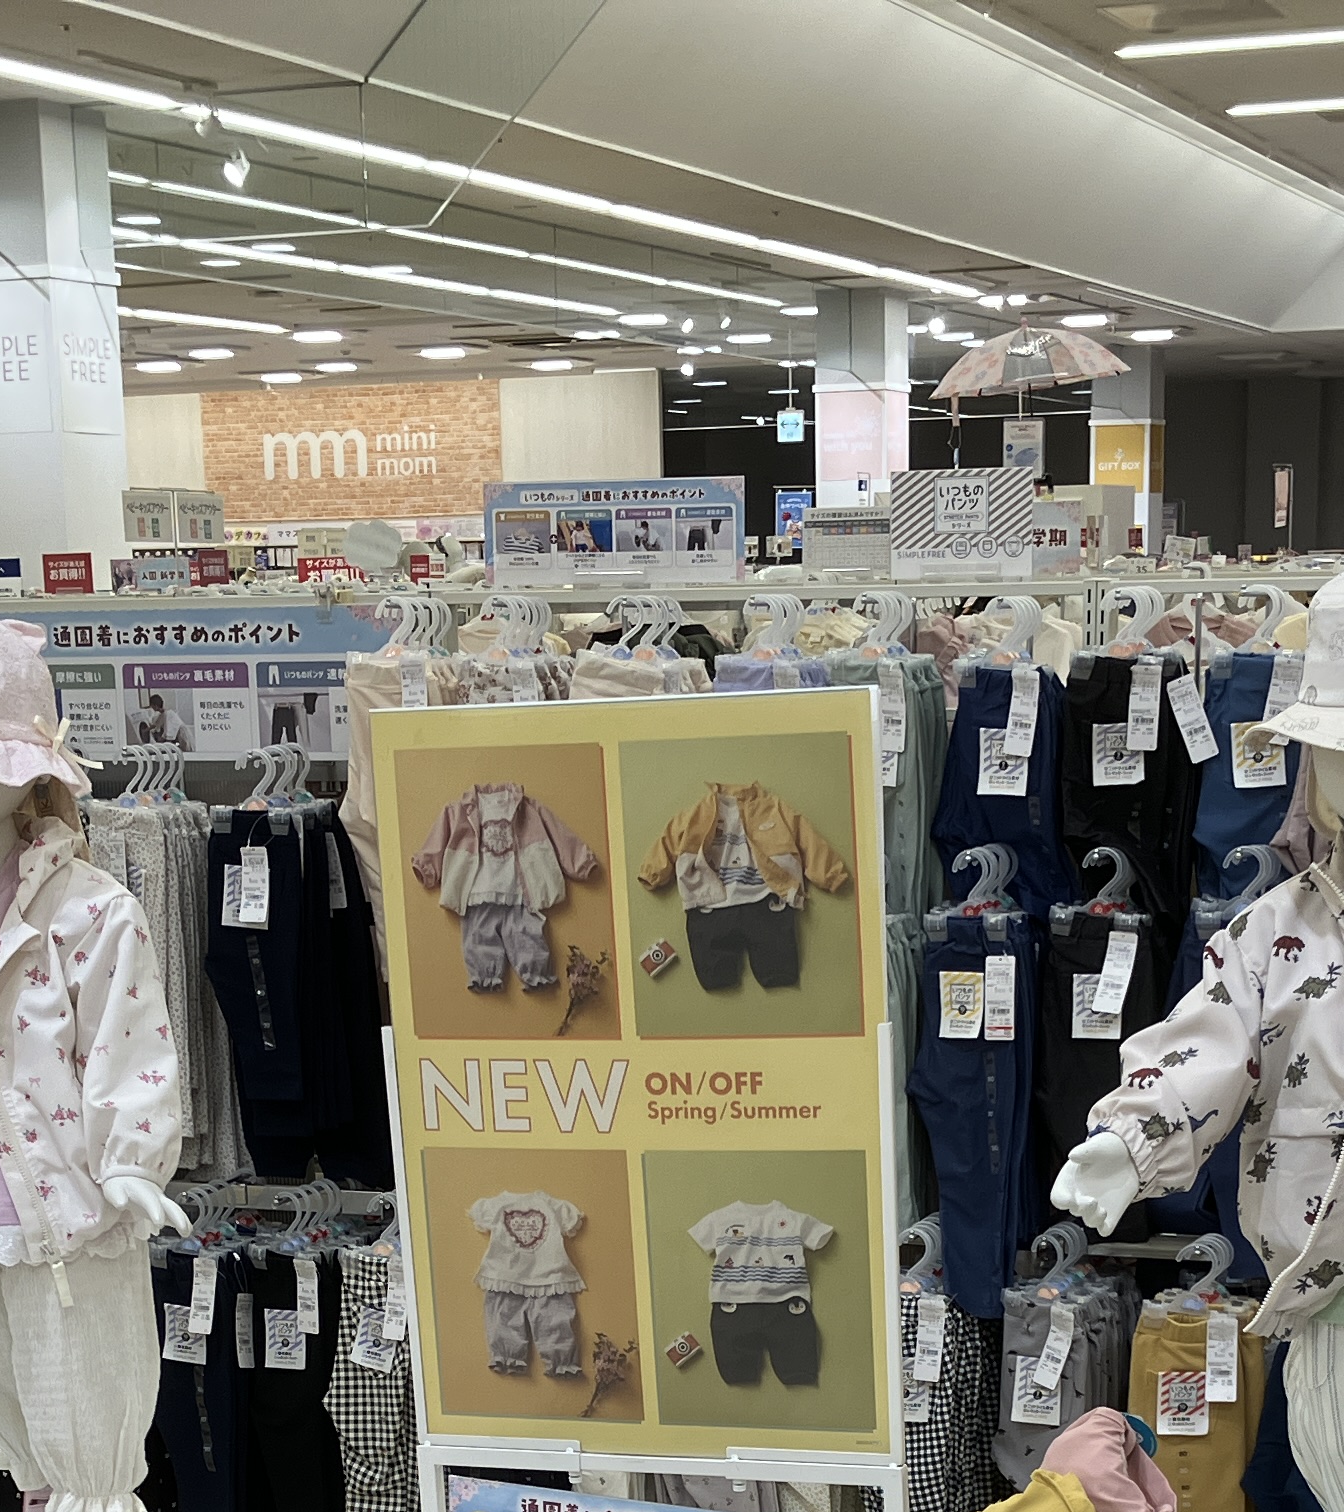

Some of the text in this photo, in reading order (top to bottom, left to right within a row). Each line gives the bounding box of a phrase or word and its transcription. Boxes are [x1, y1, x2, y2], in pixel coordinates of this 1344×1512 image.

[71, 360, 106, 383] FREE
[375, 425, 437, 451] mini
[376, 456, 437, 476] mom
[1098, 461, 1140, 471] GIFT BOX
[939, 484, 984, 497] いつもの
[944, 497, 979, 511] パンツ
[1032, 529, 1067, 548] 学期
[927, 551, 946, 559] FREE
[53, 623, 301, 648] 通園着におすすめのポイント
[152, 669, 235, 682] いつものパンツ 裏毛素材
[199, 700, 245, 711] 毎日の洗濯でも
[200, 711, 231, 721] くたくたに
[200, 722, 232, 732] なりにくい
[419, 1058, 763, 1134] NEW ON/OFF
[647, 1100, 822, 1126] Spring/Summer
